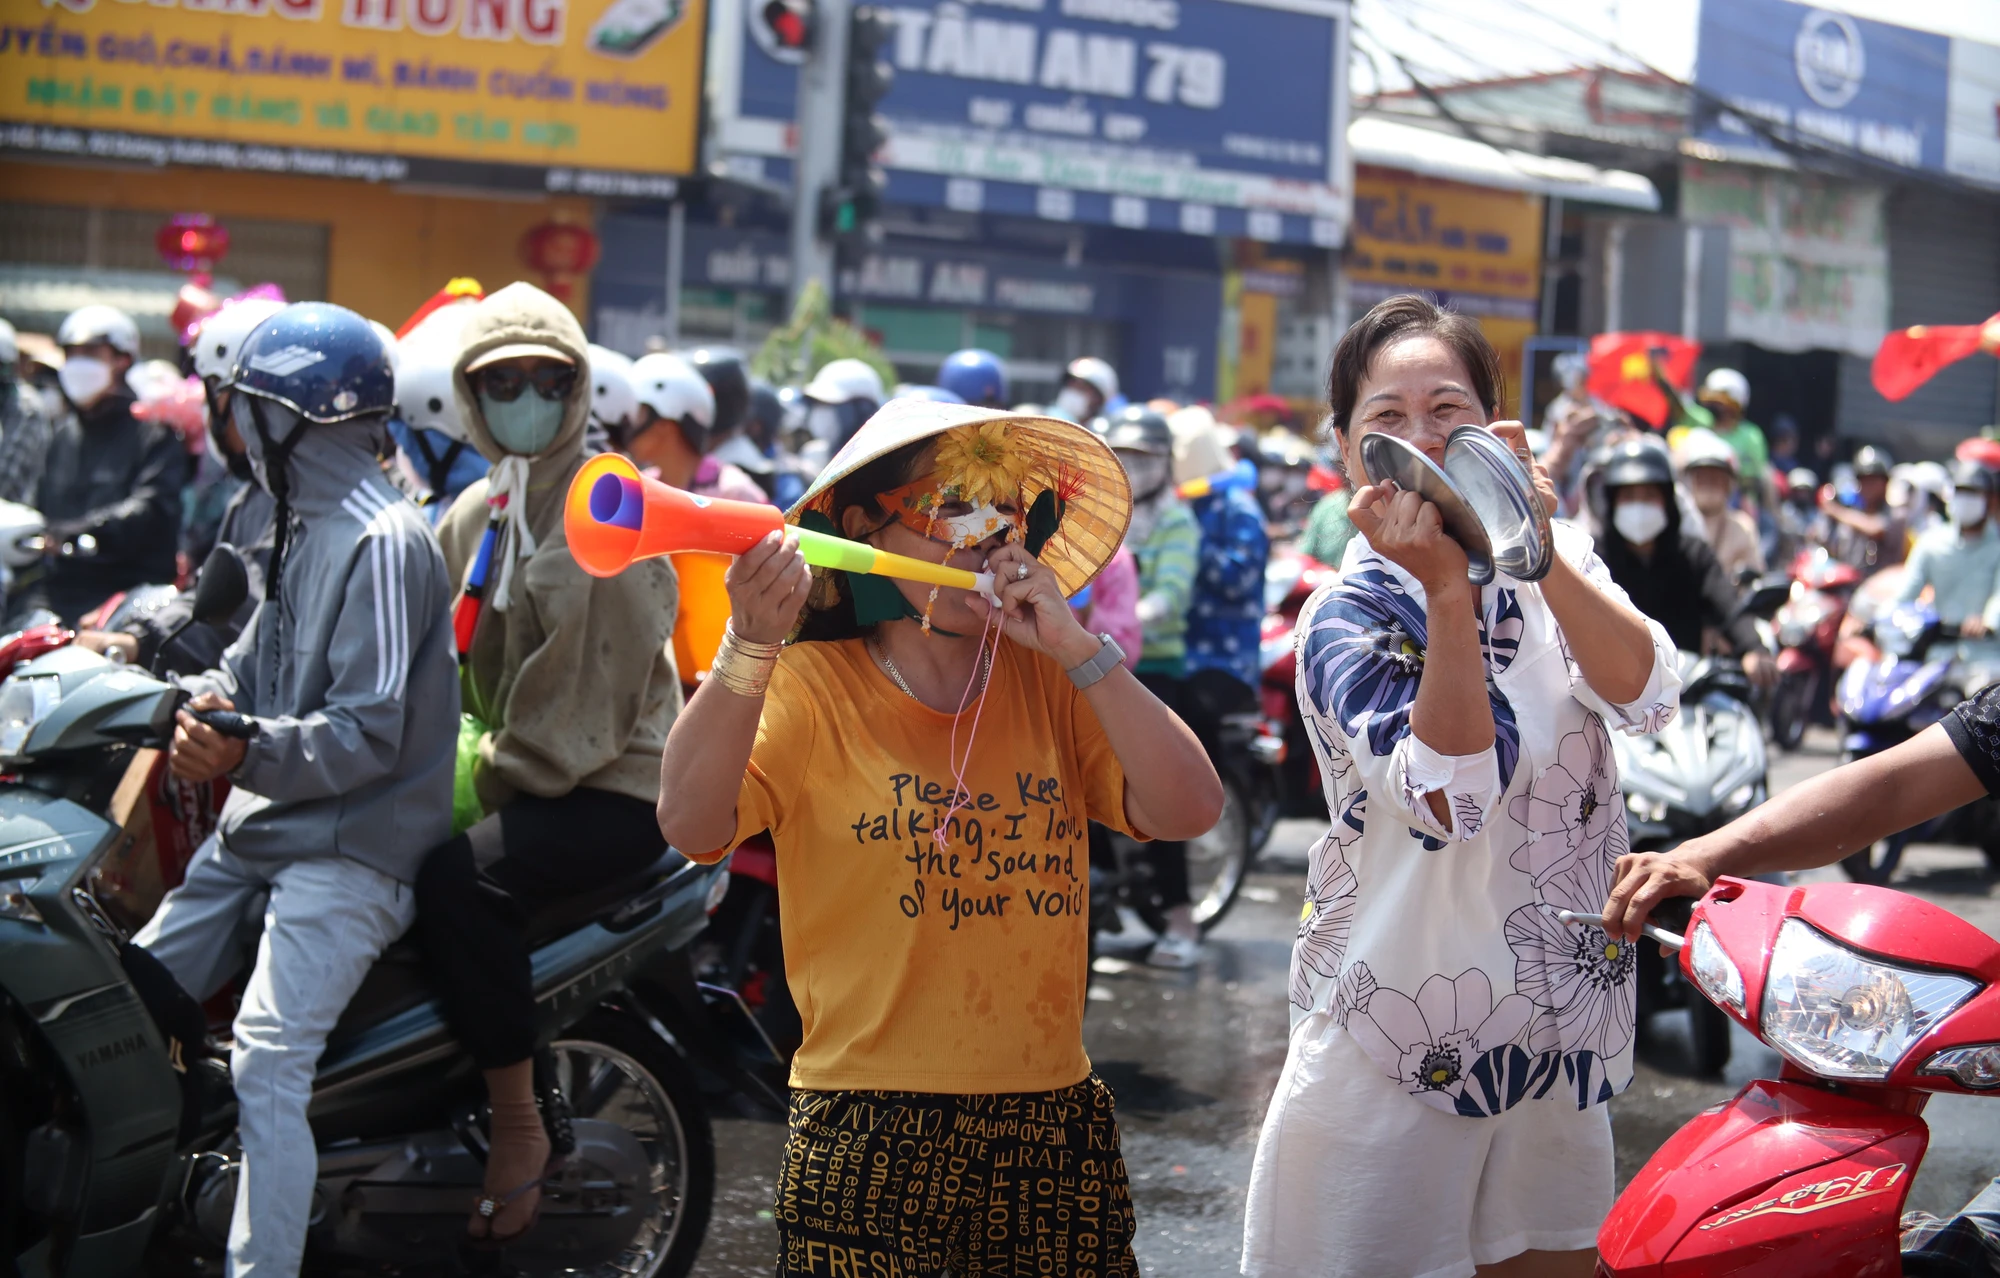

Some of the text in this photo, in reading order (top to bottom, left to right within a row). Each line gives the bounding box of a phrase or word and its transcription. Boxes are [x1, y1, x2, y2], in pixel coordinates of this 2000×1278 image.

[893, 2, 1225, 110] TÂM AN 79
[889, 773, 1001, 812] Please
[851, 808, 996, 864] talking.
[1003, 813, 1027, 841] I
[905, 840, 1079, 883] the sound
[942, 887, 1011, 931] your
[75, 1033, 147, 1069] YAMAHA
[935, 1128, 989, 1161] LATTE
[1017, 1145, 1074, 1171] RAF
[784, 1133, 810, 1223] ROMANO
[801, 1140, 831, 1206] LATTE
[840, 1133, 870, 1222] espresso
[863, 1135, 892, 1236] romano
[804, 1215, 860, 1237] CREAM
[1018, 1179, 1030, 1237] CREAM
